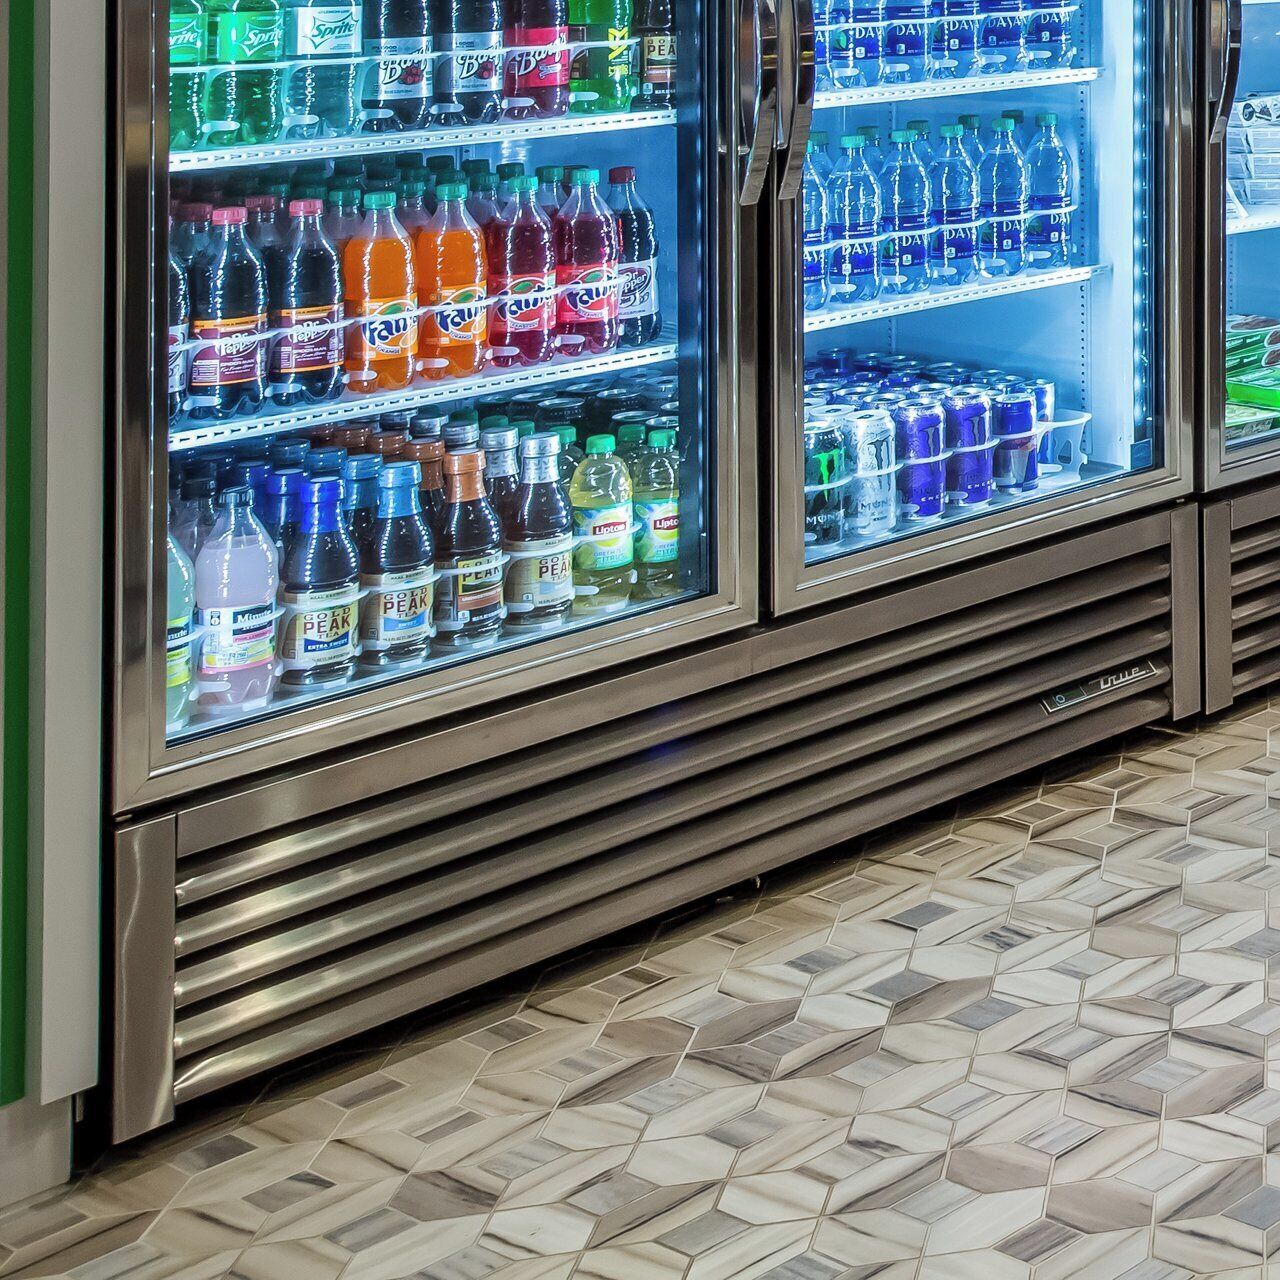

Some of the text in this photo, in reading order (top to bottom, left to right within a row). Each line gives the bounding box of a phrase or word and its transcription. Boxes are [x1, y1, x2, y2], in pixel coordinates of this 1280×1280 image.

[311, 21, 356, 41] Sprite
[595, 523, 625, 535] Lipton
[383, 587, 428, 601] GOLD
[383, 594, 428, 615] PEAK
[303, 607, 352, 621] GOLD
[303, 614, 351, 635] PEAK
